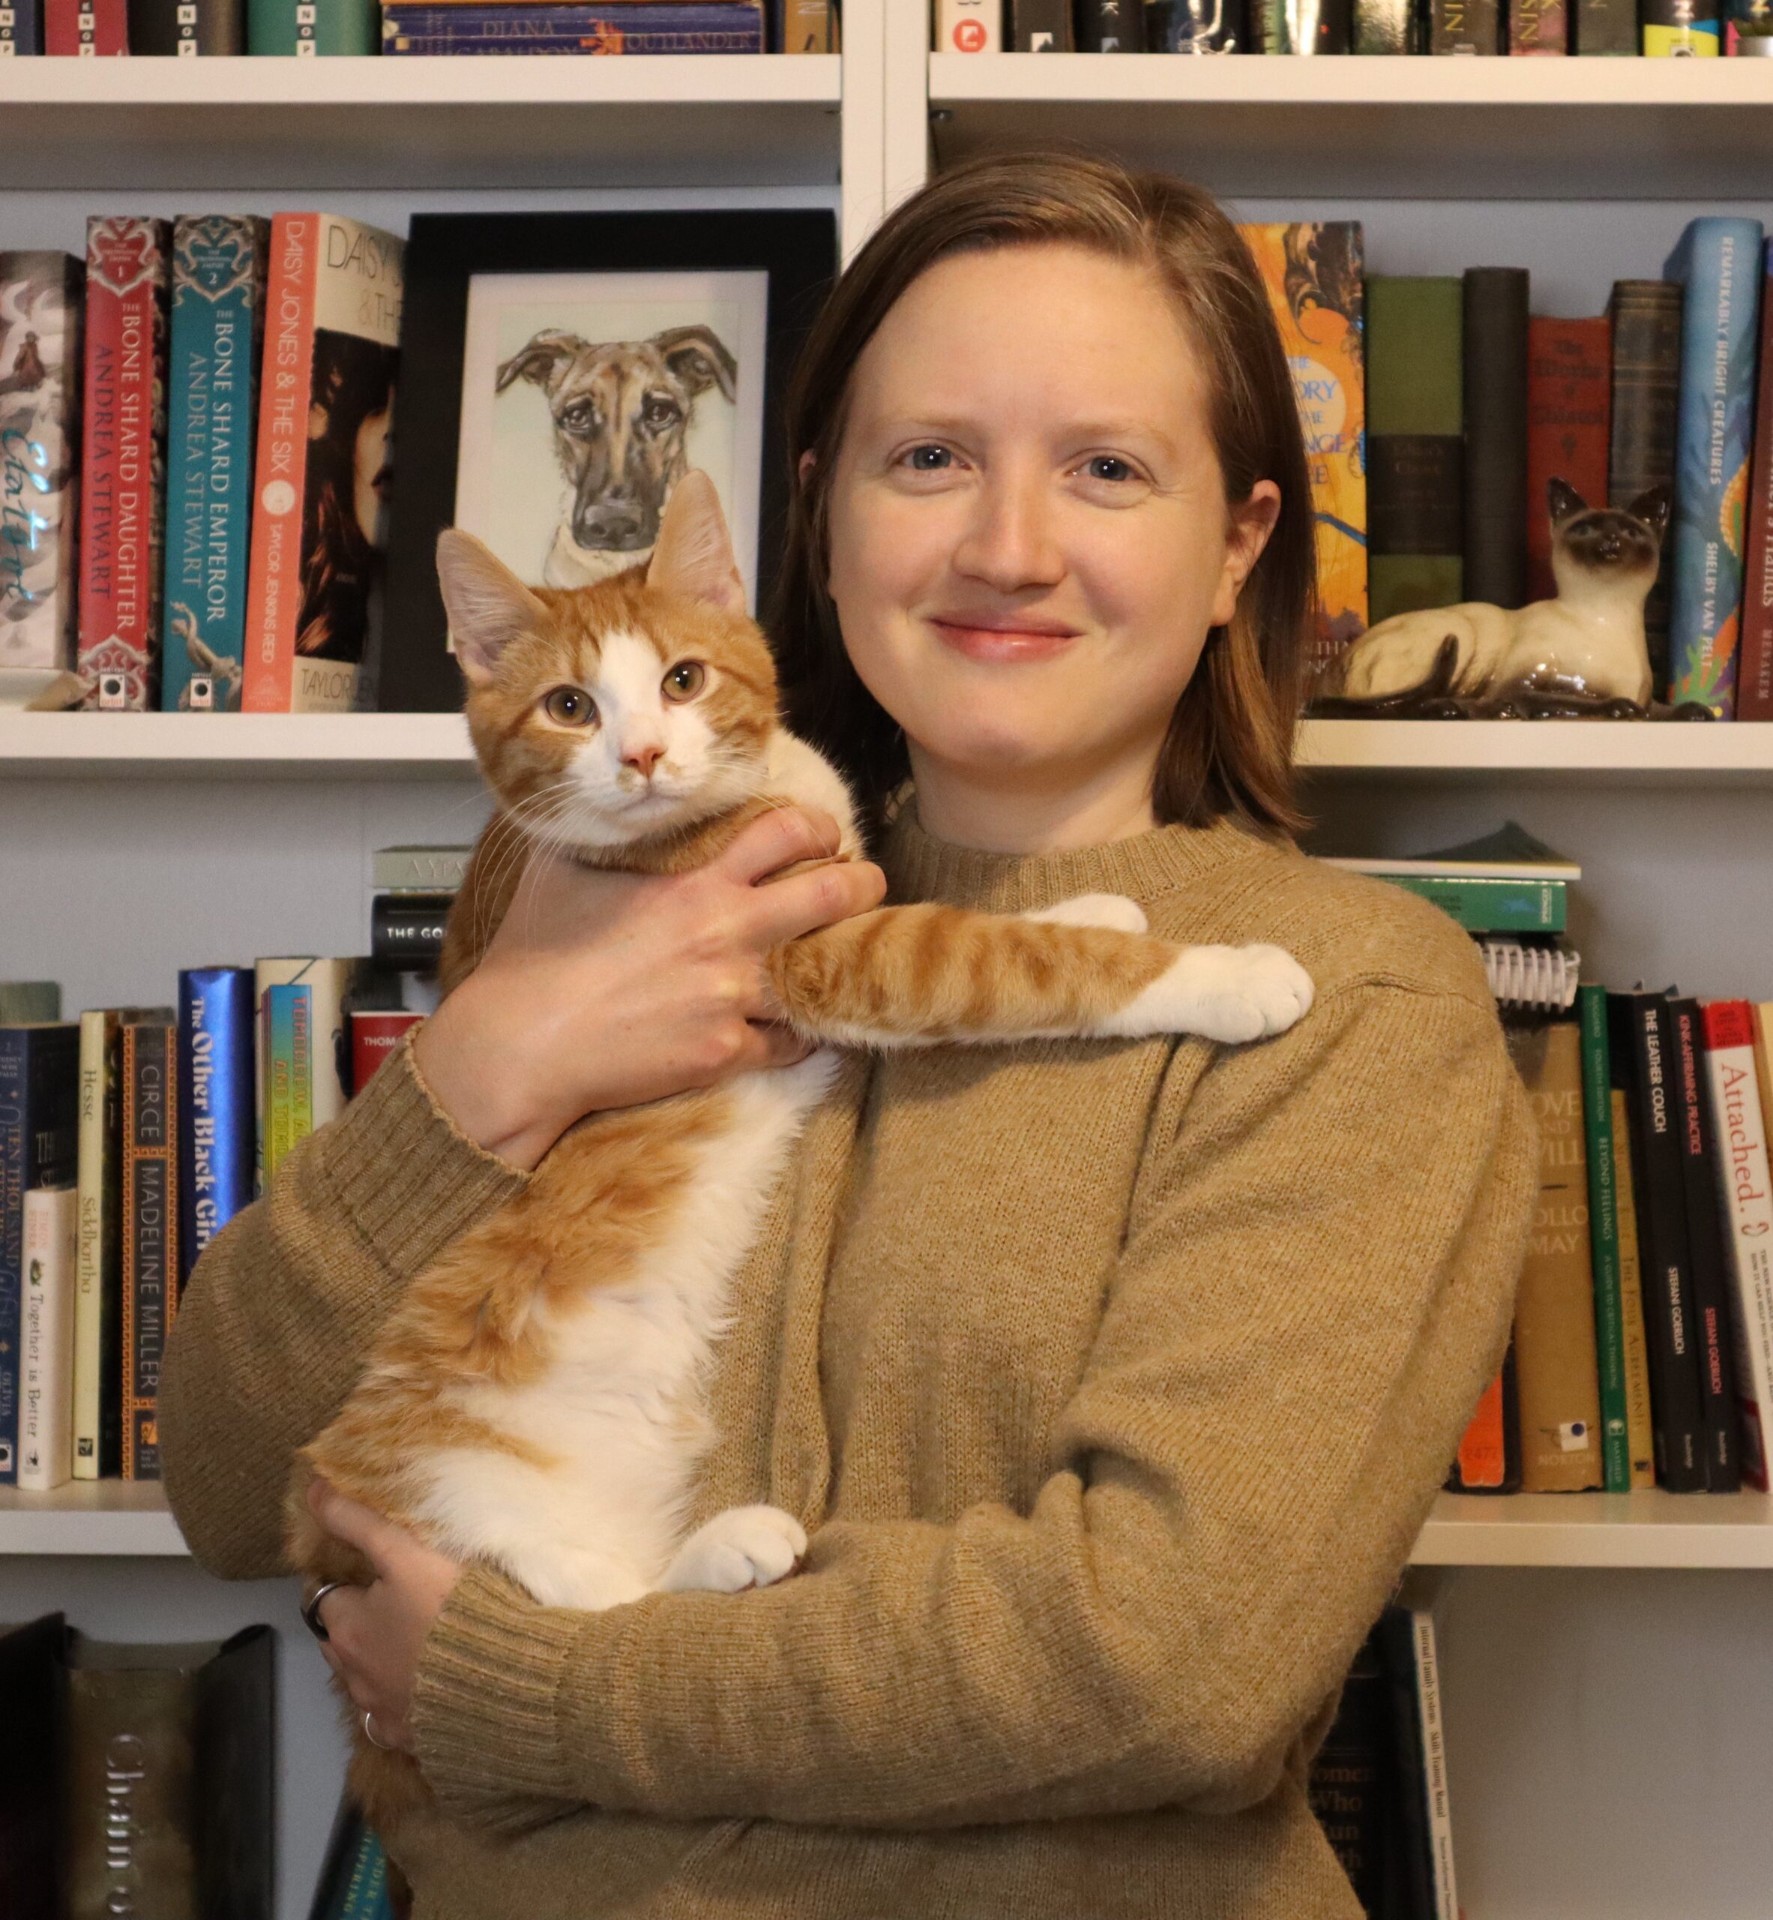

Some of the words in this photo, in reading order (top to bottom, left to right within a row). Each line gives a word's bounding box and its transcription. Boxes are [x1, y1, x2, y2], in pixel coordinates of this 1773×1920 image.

[483, 20, 554, 36] DIANA
[626, 34, 751, 49] OUTLANDER
[209, 273, 217, 284] 2
[283, 222, 305, 285] DAISY
[1718, 237, 1734, 335] REMARKABLY
[121, 315, 141, 383] BONE
[277, 288, 301, 366] JONES
[213, 322, 234, 392] BONE
[276, 372, 296, 390] &
[1715, 340, 1729, 395] BRIGHT
[93, 346, 114, 461] ANDREA
[185, 353, 208, 462] ANDREA
[273, 395, 294, 434] THE
[119, 392, 140, 482] SHARD
[210, 401, 232, 493] SHARD
[270, 441, 292, 473] SIX
[1709, 400, 1726, 485] CREATURES
[91, 472, 113, 599] STEWART
[182, 471, 205, 589] STEWART
[267, 523, 283, 573] TAYLOR
[117, 492, 137, 631] DAUGHTER
[206, 503, 229, 622] EMPEROR
[1704, 542, 1718, 593] SHELBY
[264, 576, 280, 631] JENKINS
[1703, 599, 1715, 630] VAN
[261, 632, 277, 664] REID
[1701, 637, 1713, 668] PELT
[302, 668, 352, 700] TAYLOR
[386, 927, 415, 939] THE
[421, 927, 448, 939] GO
[191, 997, 204, 1028] The
[1645, 1009, 1658, 1032] THE
[364, 1036, 398, 1047] THOM
[1647, 1035, 1663, 1084] LEATHER
[82, 1070, 97, 1121] Hesse
[191, 1031, 214, 1111] Other
[140, 1065, 160, 1138] CIRCE
[1532, 1091, 1581, 1117] OVE
[1543, 1120, 1570, 1134] ND
[1652, 1087, 1667, 1133] COUCH
[194, 1118, 216, 1191] Black
[1686, 1105, 1702, 1155] PRACTICE
[1721, 1062, 1764, 1213] Attached.
[1599, 1138, 1610, 1185] BEYOND
[140, 1167, 160, 1295] MADELINE
[1533, 1205, 1589, 1227] OLLO
[1600, 1189, 1612, 1240] FEELINGS
[80, 1197, 97, 1294] Siddhartha
[1668, 1267, 1680, 1305] STEFANI
[28, 1294, 44, 1360] Together
[140, 1305, 160, 1388] MILLER
[1705, 1307, 1717, 1345] STEFANI
[28, 1369, 40, 1382] is
[27, 1389, 42, 1437] Better
[106, 1733, 146, 1870] Chain
[343, 1826, 373, 1913] ISPERING
[365, 1856, 386, 1900] NDER
